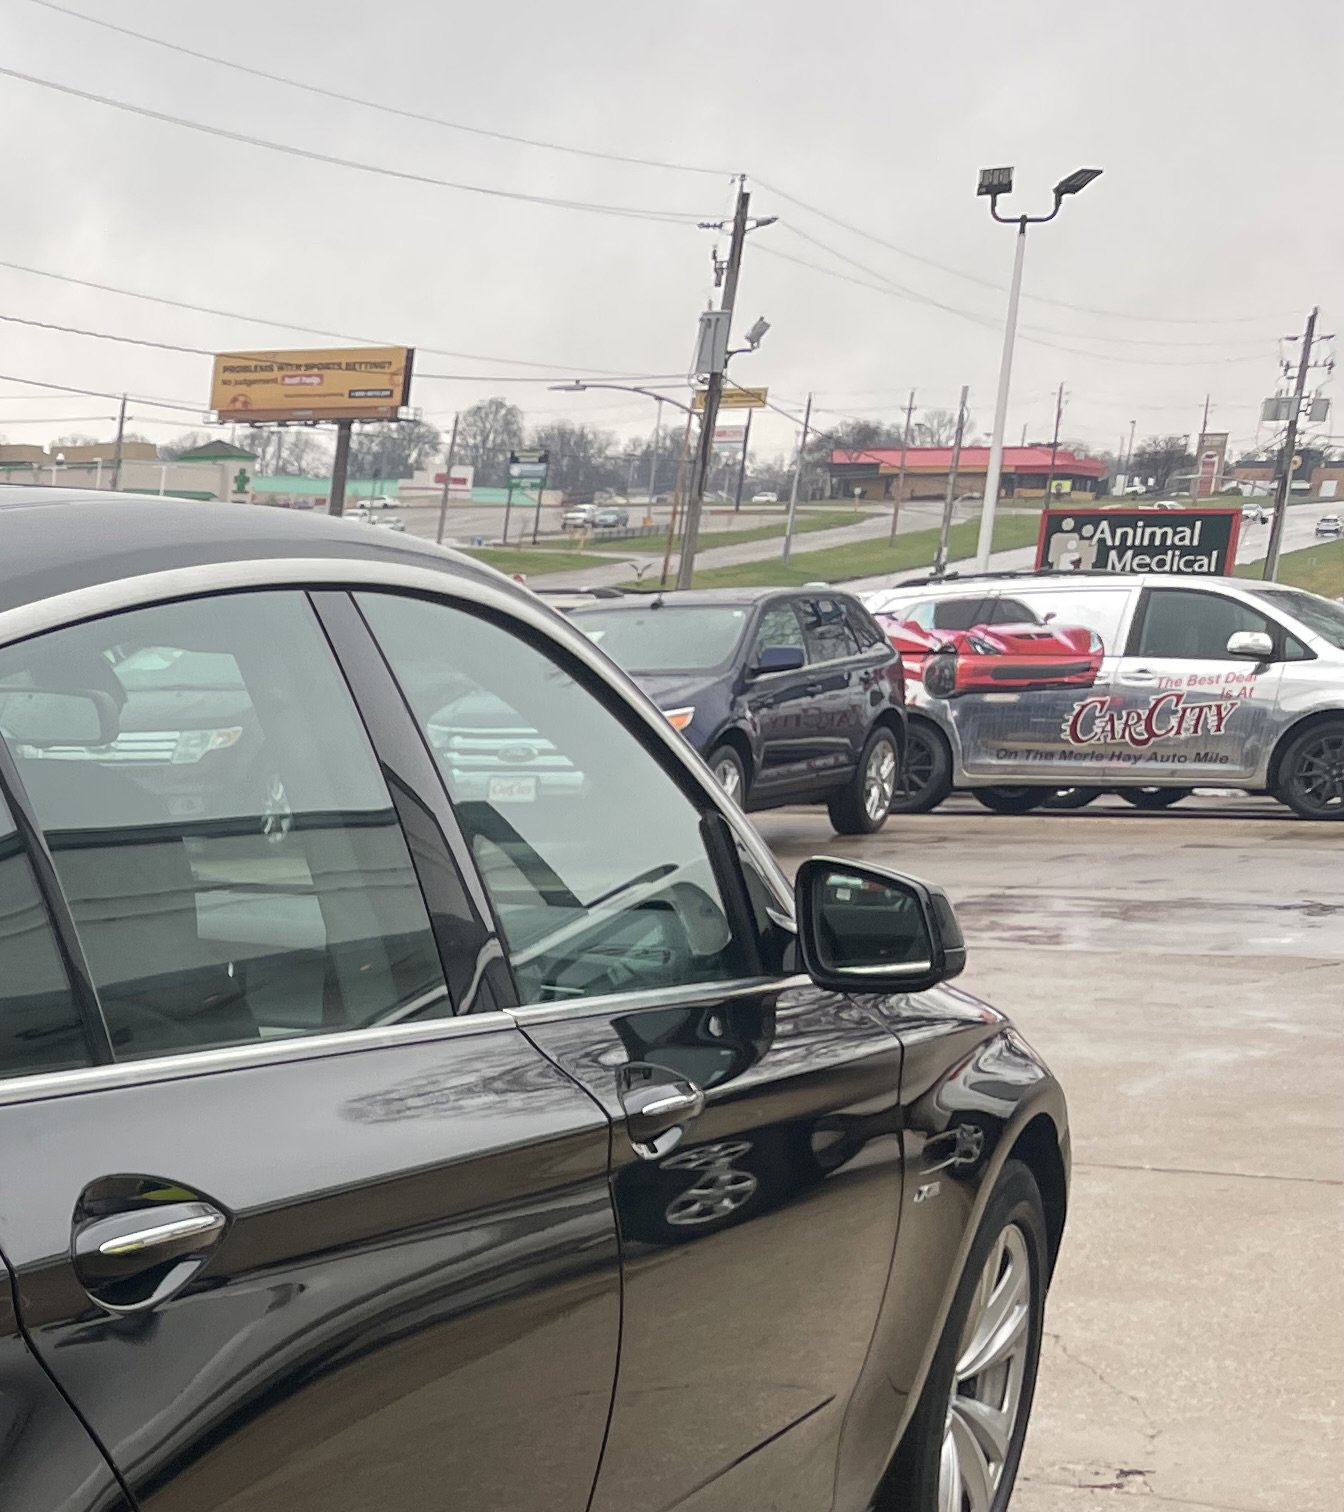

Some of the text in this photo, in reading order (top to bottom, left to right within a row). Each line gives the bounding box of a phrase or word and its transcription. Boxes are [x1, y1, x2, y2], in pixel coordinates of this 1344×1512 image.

[1092, 520, 1203, 547] Animal
[1107, 549, 1218, 573] Medical
[1157, 675, 1183, 689] The
[1186, 673, 1221, 687] Best
[1235, 685, 1255, 699] At
[996, 748, 1019, 760] On
[1023, 748, 1056, 761] The
[1110, 750, 1139, 766] Hay
[1142, 751, 1189, 764] Auto
[1193, 751, 1230, 765] Mile
